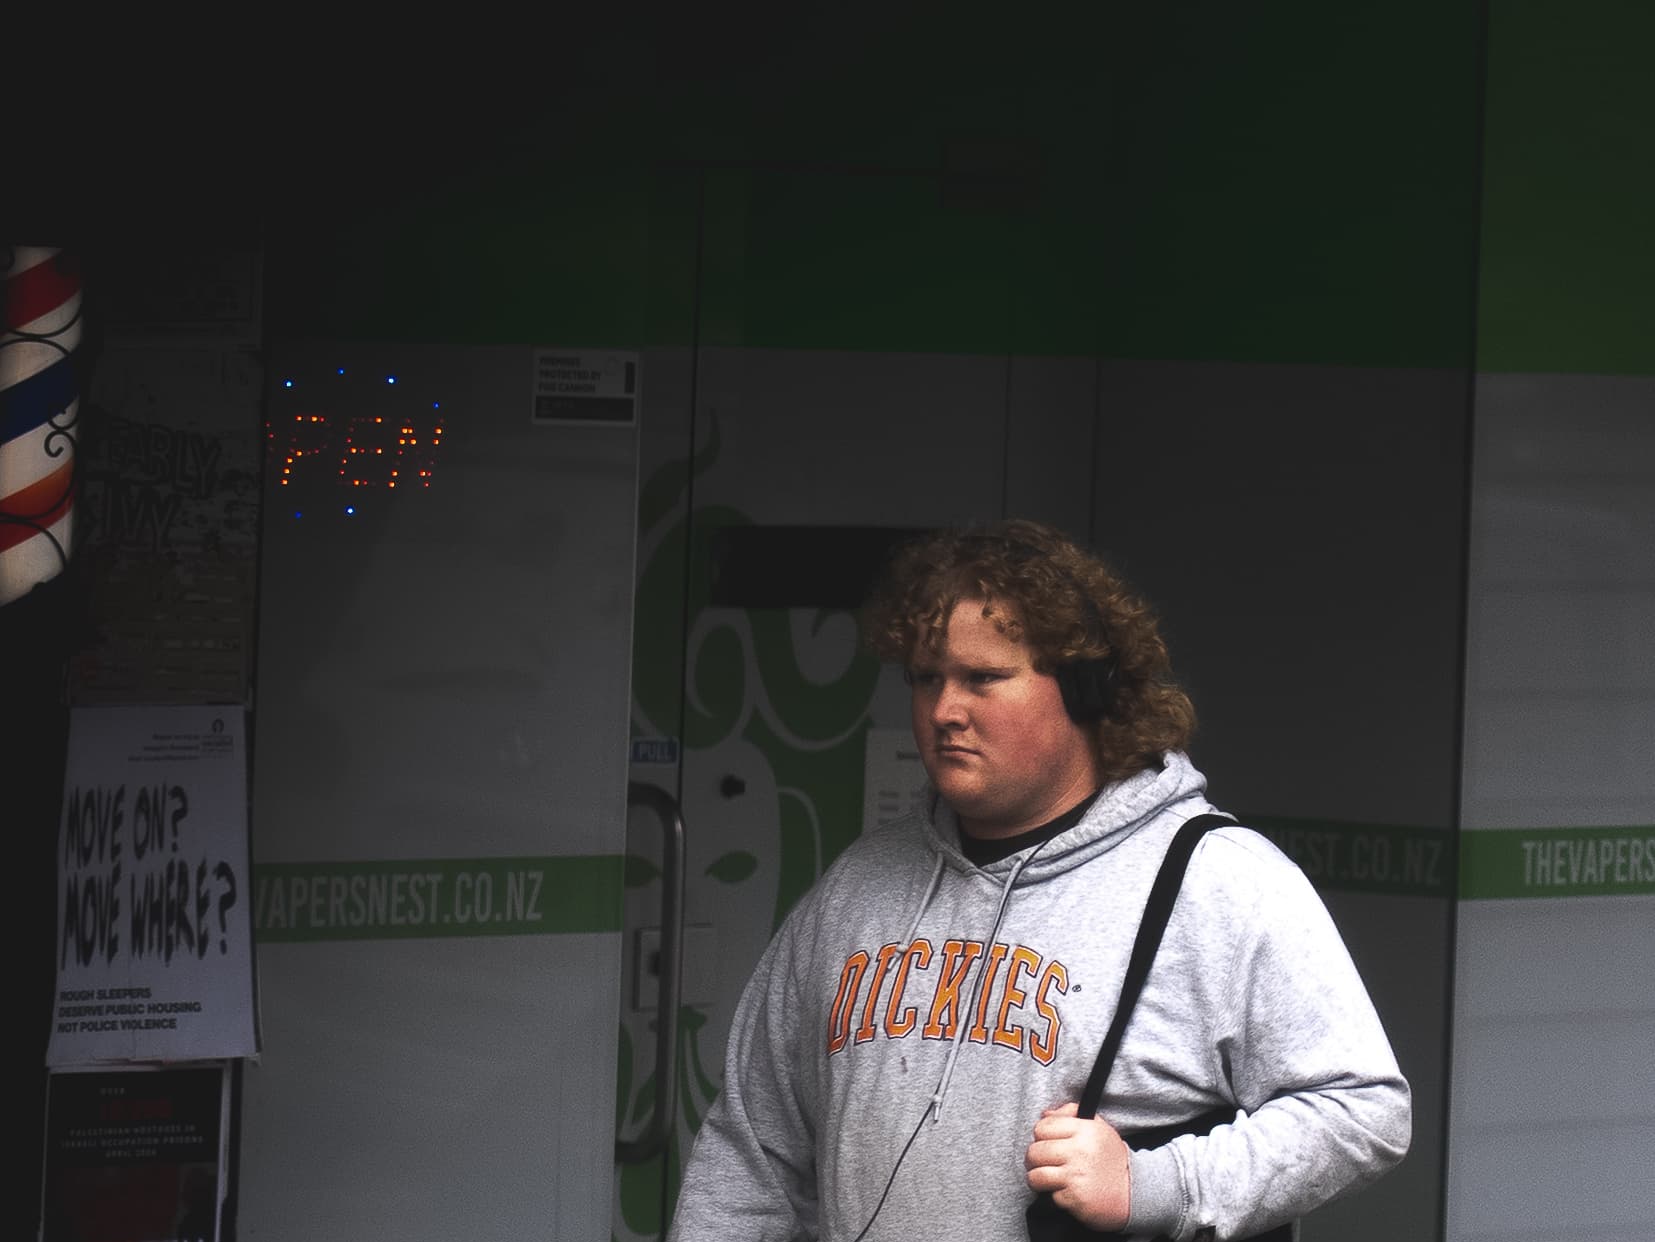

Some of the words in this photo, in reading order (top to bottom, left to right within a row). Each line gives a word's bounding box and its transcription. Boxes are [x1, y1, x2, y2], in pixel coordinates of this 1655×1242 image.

[640, 743, 672, 760] PULL
[64, 784, 126, 869] MOVE
[133, 779, 189, 860] ON?
[62, 861, 122, 971] MOVE
[130, 858, 237, 967] WHERE?
[60, 990, 94, 1001] ROUGH
[828, 938, 1070, 1067] DICKIES
[58, 1005, 104, 1017] DESERVE
[105, 1003, 145, 1016] PUBLIC
[57, 1022, 78, 1033] NOT
[80, 1020, 119, 1032] POLICE
[121, 1018, 177, 1031] VIOLENCE
